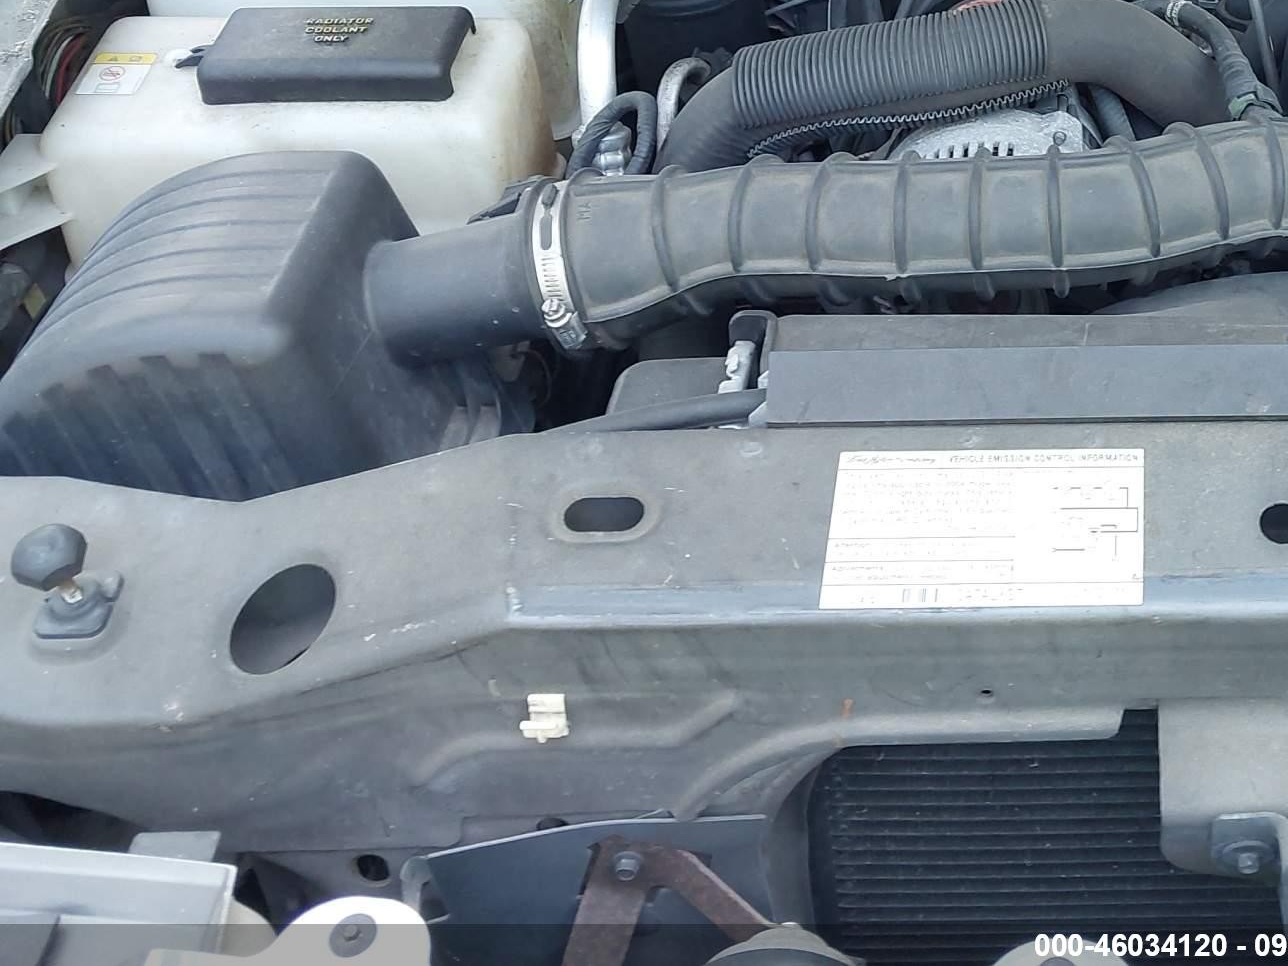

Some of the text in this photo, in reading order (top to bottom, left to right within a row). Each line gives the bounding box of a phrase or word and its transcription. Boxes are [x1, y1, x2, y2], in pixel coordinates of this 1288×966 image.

[304, 17, 374, 25] RADIATOR
[305, 26, 368, 34] COOLANT
[314, 35, 349, 43] ONLY
